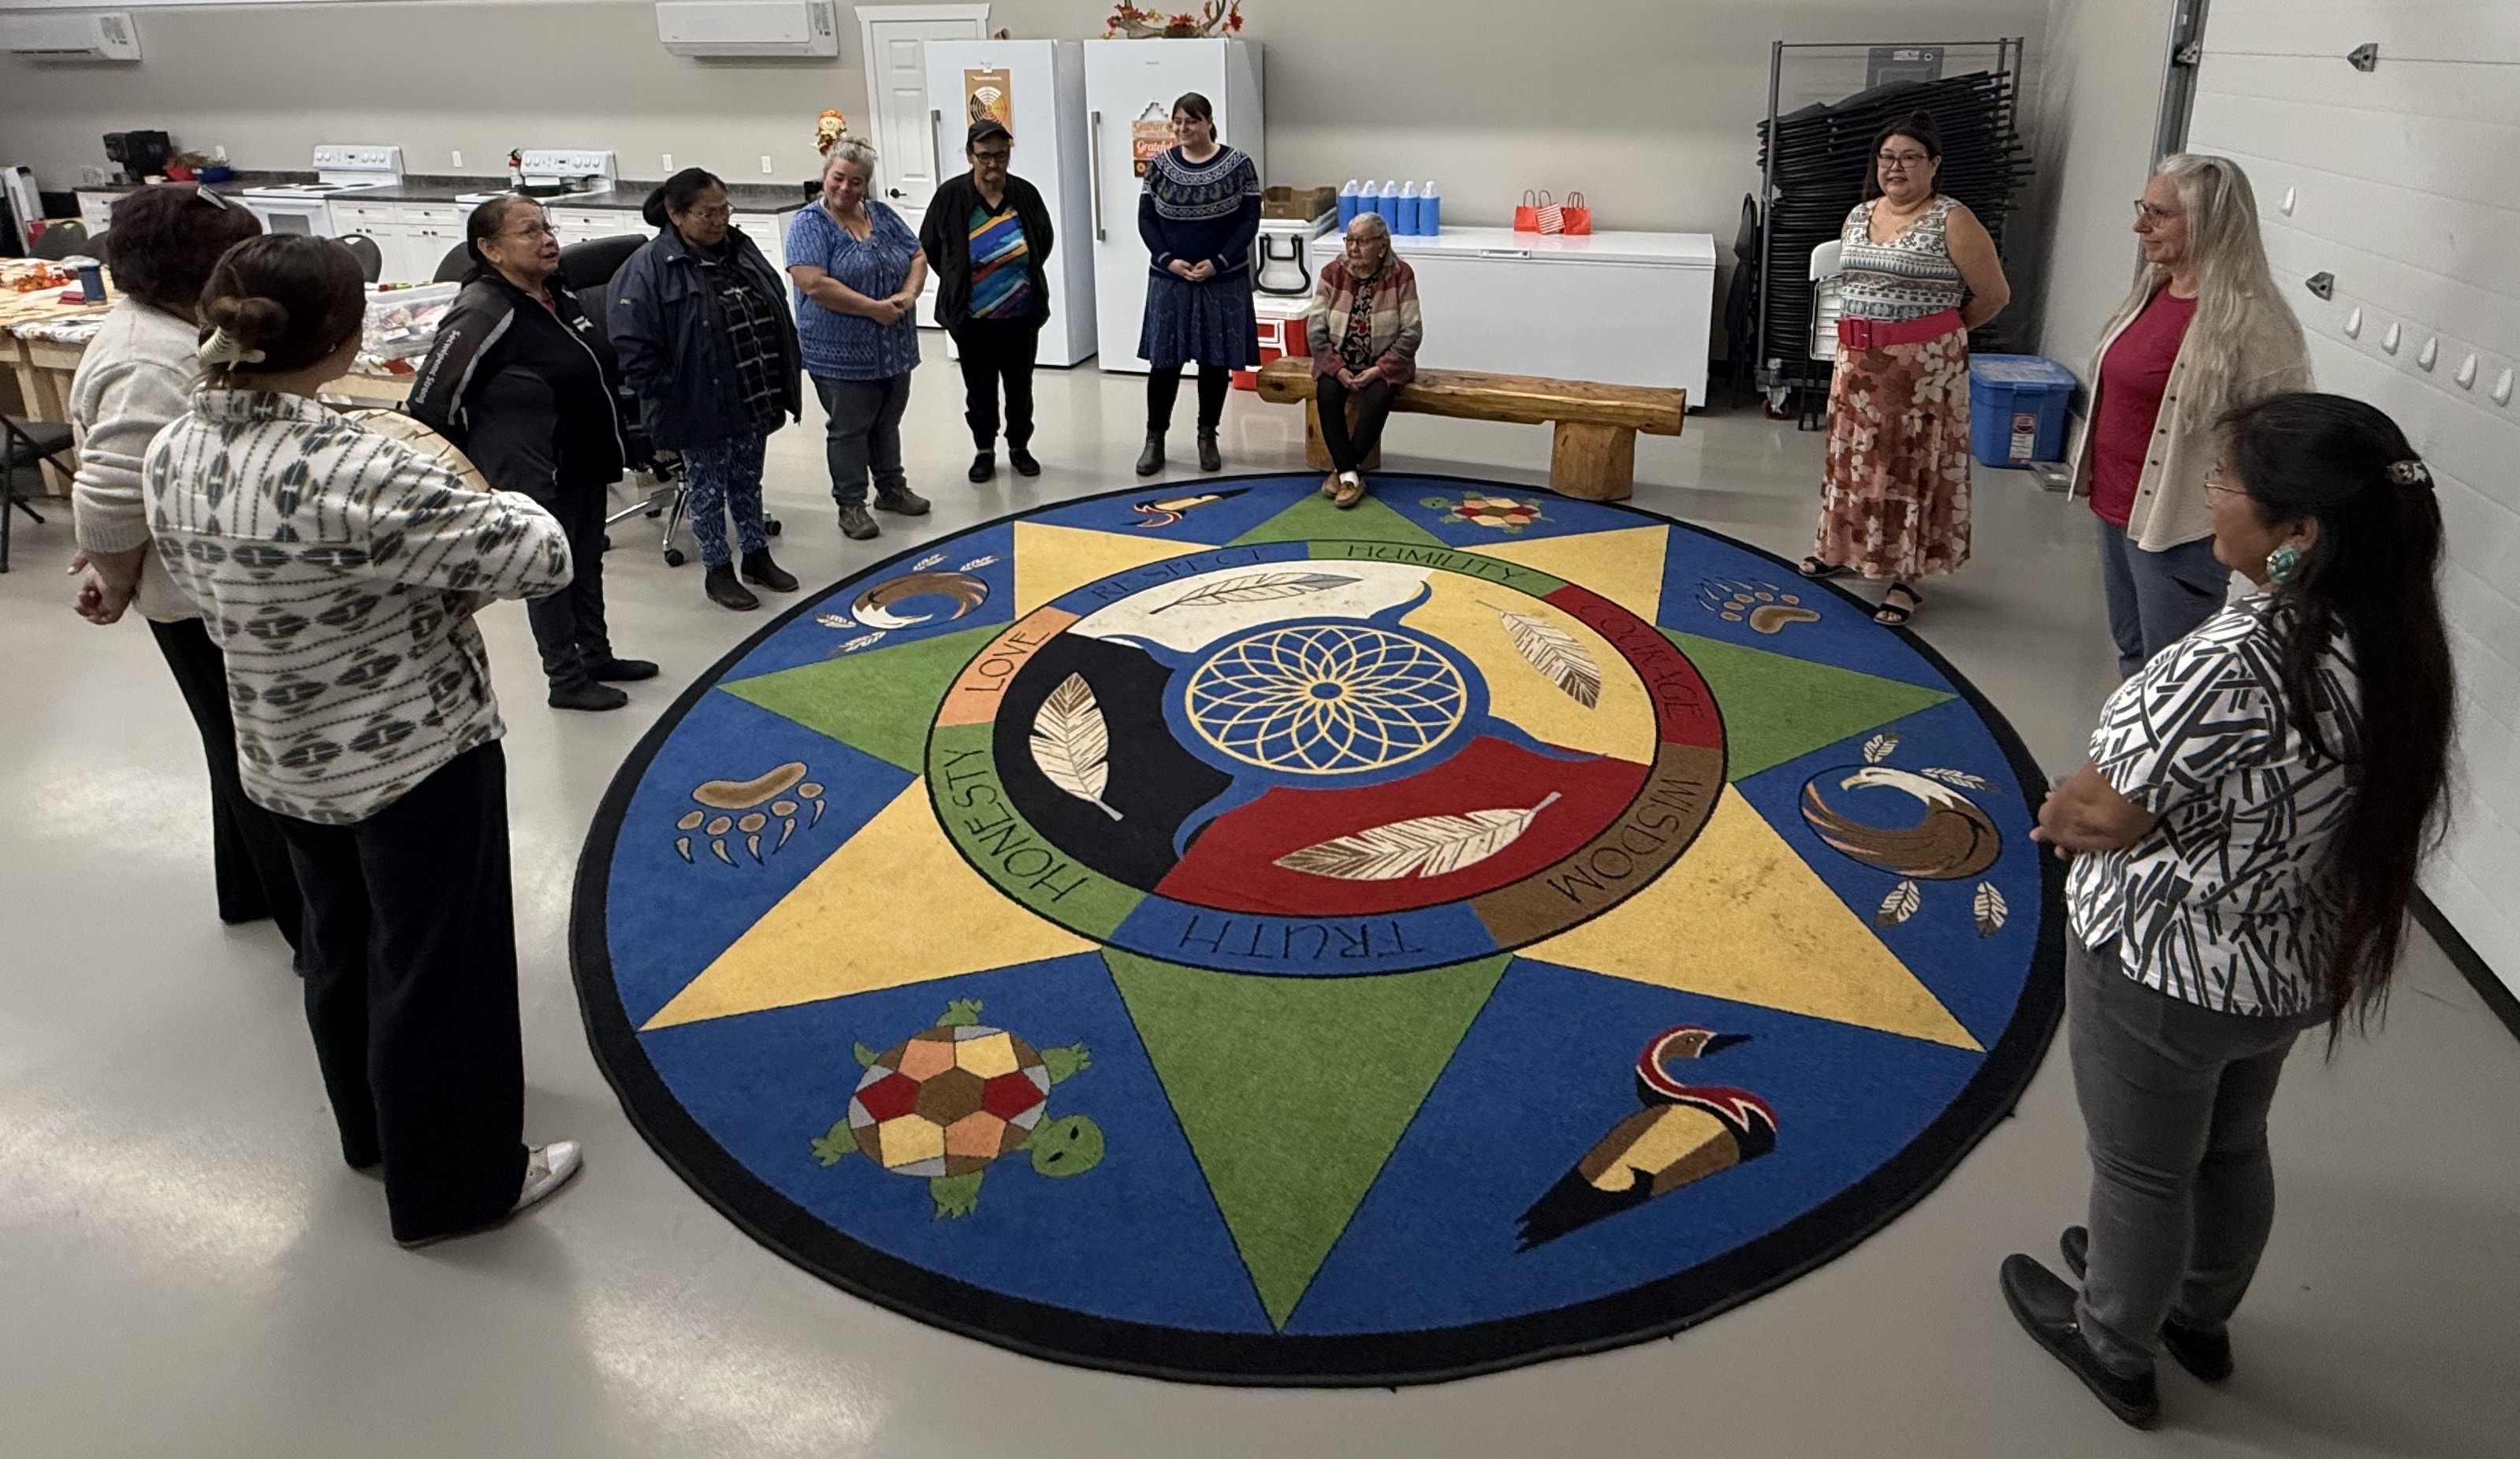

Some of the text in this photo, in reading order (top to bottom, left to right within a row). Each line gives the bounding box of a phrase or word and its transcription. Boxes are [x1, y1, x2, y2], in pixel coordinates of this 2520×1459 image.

[415, 376, 434, 404] Strong
[1091, 549, 1272, 601] RESPECT
[1347, 545, 1528, 582] HUMILITY
[964, 631, 1051, 691] LOVE
[1579, 605, 1707, 721] COURAGE
[944, 750, 1089, 903] HONESTY
[1547, 779, 1703, 903] WISDOM
[1179, 914, 1424, 959] TRUTH
